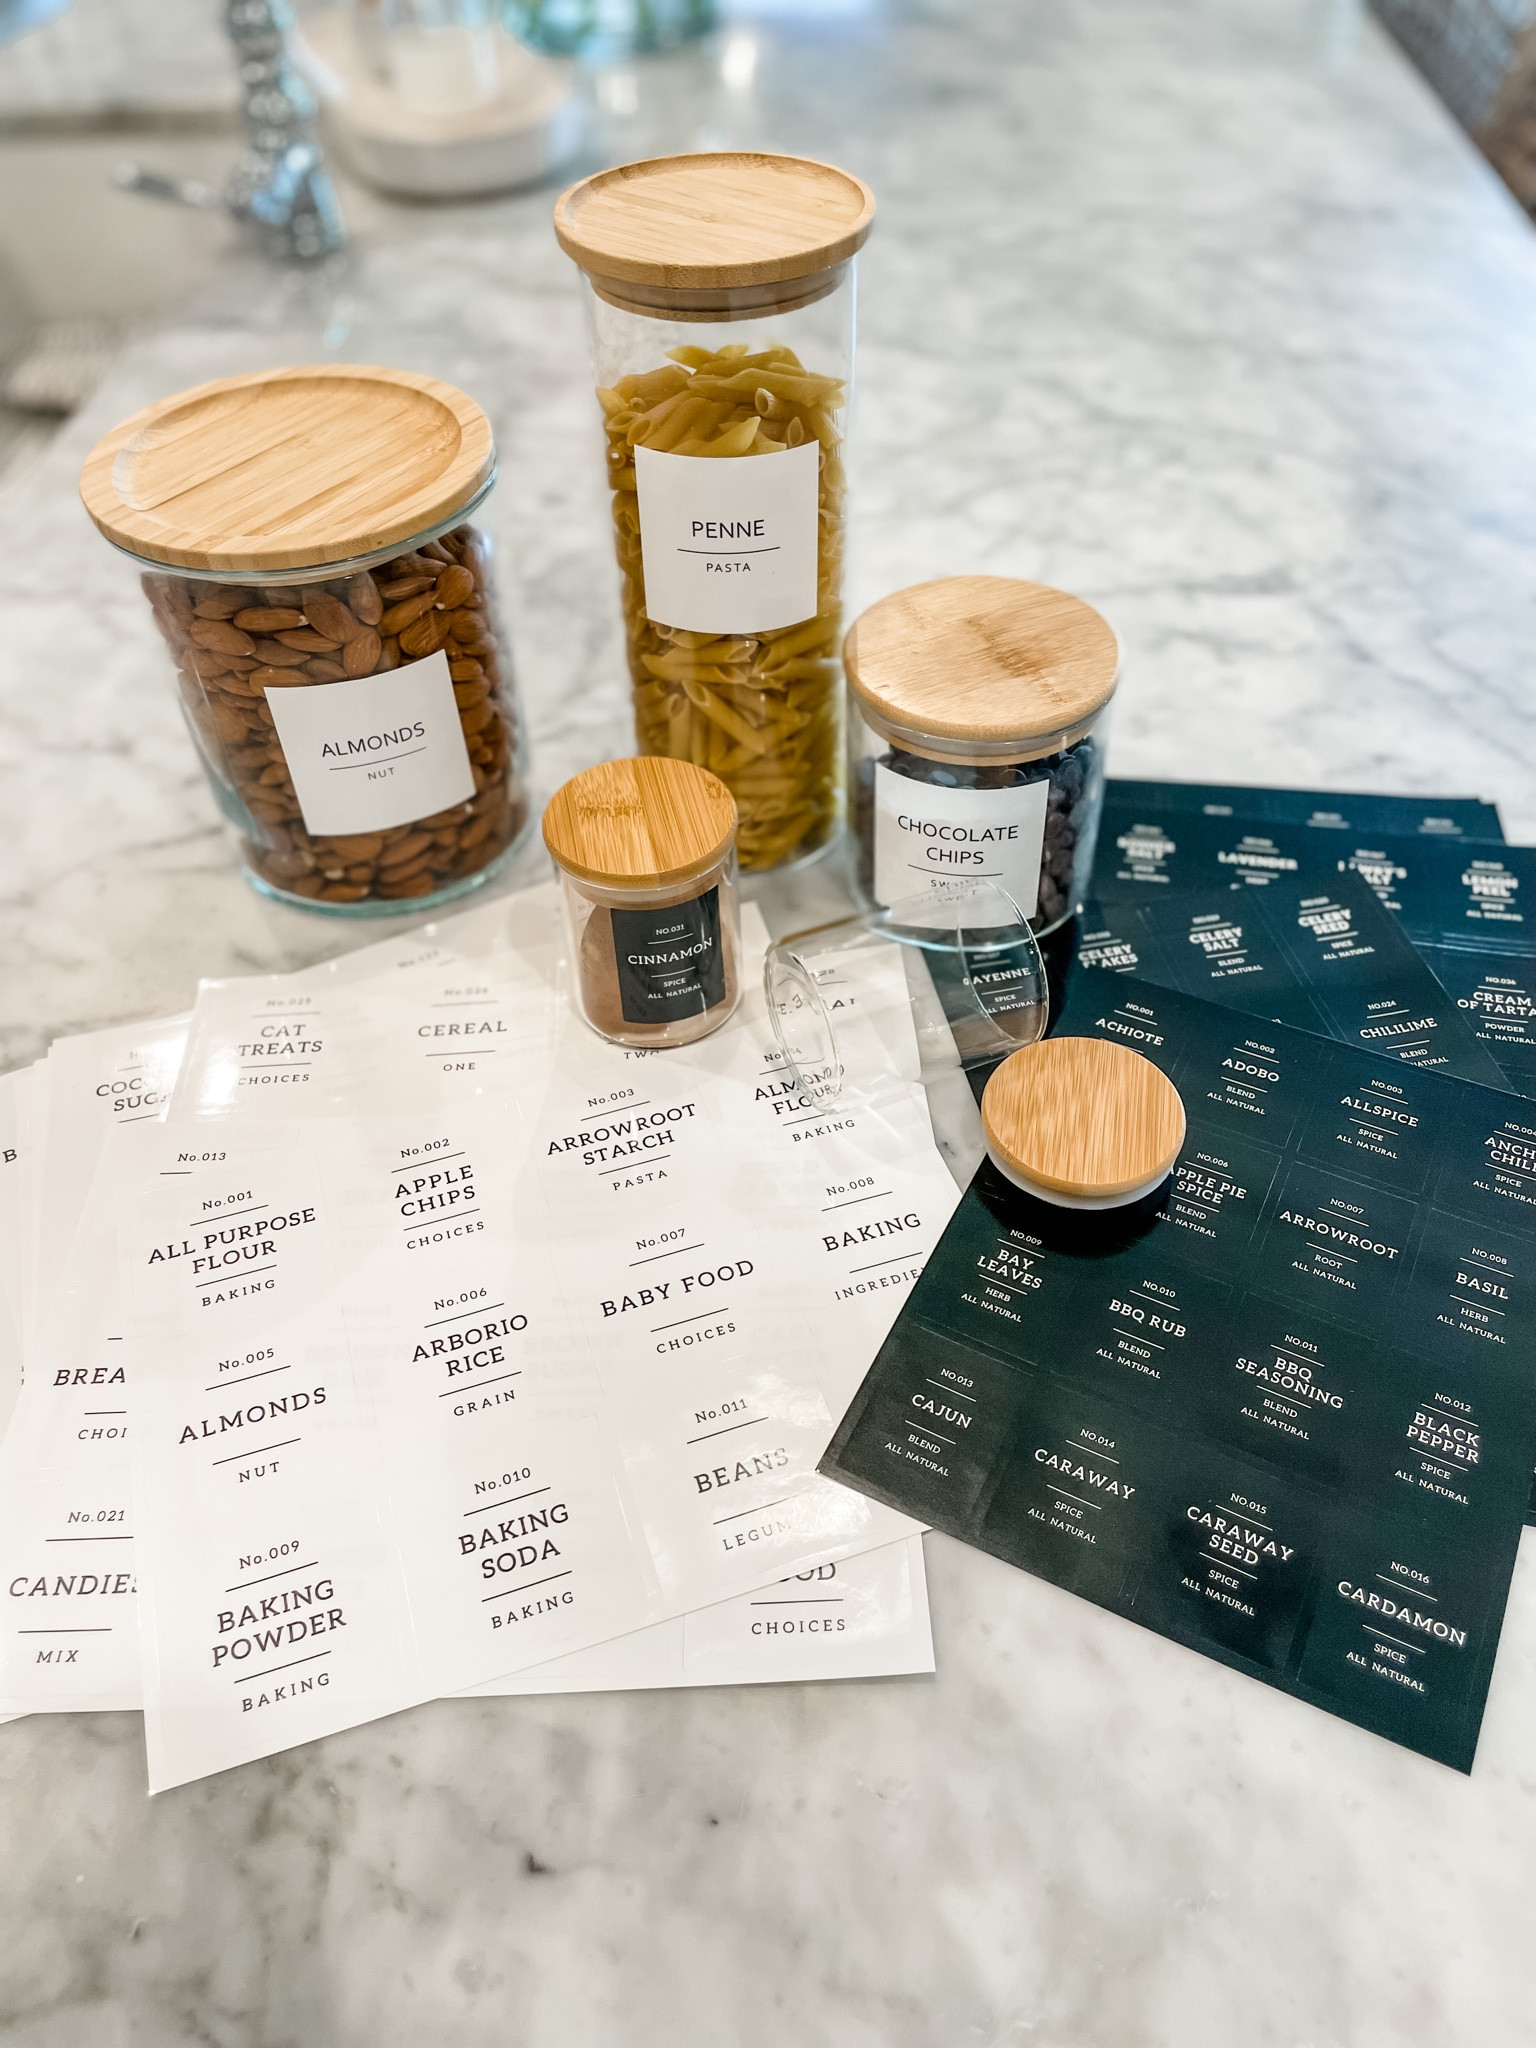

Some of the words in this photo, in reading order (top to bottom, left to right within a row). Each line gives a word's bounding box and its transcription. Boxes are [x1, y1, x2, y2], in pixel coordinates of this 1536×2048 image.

[692, 519, 765, 539] PENNE
[706, 563, 751, 572] PASTA
[321, 722, 425, 758] ALMONDS
[367, 767, 395, 780] NUT
[897, 815, 1018, 841] CHOCOLATE
[926, 847, 984, 865] CHIPS
[1298, 908, 1351, 928] CELERY
[1313, 920, 1350, 935] SEED
[655, 924, 685, 935] NO.031
[1189, 927, 1242, 944] CELERY
[627, 937, 713, 965] CINNAMON
[1078, 944, 1132, 962] CELERY
[1203, 938, 1239, 952] SALT
[1218, 958, 1245, 967] BLEND
[1227, 965, 1263, 975] NATURAL
[663, 978, 686, 987] SPICE
[666, 984, 702, 998] NATURAL
[1485, 976, 1516, 985] NO.036
[1125, 1002, 1154, 1016] NO.001
[1367, 1001, 1396, 1010] NO.024
[1457, 999, 1478, 1010] OF
[1473, 991, 1531, 1006] CREAM
[261, 1024, 306, 1037] CAT
[418, 1021, 508, 1037] CEREAL
[1095, 1018, 1164, 1046] ACHIOTE
[1360, 1018, 1437, 1038] CHILILIME
[1475, 1031, 1491, 1039] ALL
[1484, 1022, 1525, 1033] POWDER
[238, 1041, 323, 1057] TREATS
[1244, 1039, 1275, 1054] NO.002
[1400, 1048, 1428, 1059] BLEND
[443, 1062, 476, 1071] ONE
[1221, 1058, 1280, 1082] ADOBO
[238, 1074, 310, 1085] CHOICES
[1370, 1079, 1403, 1095] NO.003
[588, 1088, 635, 1107] No.003
[1207, 1091, 1223, 1102] ALL
[1226, 1097, 1266, 1115] NATURAL
[1226, 1085, 1256, 1100] BLEND
[1340, 1096, 1419, 1127] ALLSPICE
[547, 1103, 695, 1155] ARROWROOT
[792, 1119, 856, 1142] BAKING
[1358, 1128, 1384, 1142] SPICE
[400, 1138, 450, 1158] No.002
[583, 1130, 675, 1166] STARCH
[1336, 1133, 1352, 1144] ALL
[1356, 1140, 1398, 1159] NATURAL
[177, 1152, 227, 1162] No.013
[1196, 1152, 1229, 1168] NO.006
[395, 1165, 474, 1198] APPLE
[612, 1170, 667, 1190] PASTA
[826, 1177, 875, 1196] No.008
[1473, 1180, 1490, 1190] ALL
[1495, 1174, 1522, 1187] SPICE
[202, 1190, 253, 1210] No.001
[400, 1185, 475, 1216] CHIPS
[1176, 1181, 1223, 1204] SPICE
[1221, 1183, 1247, 1200] PIE
[1175, 1204, 1207, 1220] BLEND
[1330, 1198, 1365, 1214] NO.007
[407, 1221, 484, 1249] CHOICES
[822, 1213, 921, 1252] BAKING
[1155, 1211, 1172, 1222] ALL
[1174, 1218, 1217, 1238] NATURAL
[1279, 1210, 1399, 1260] ARROWROOT
[148, 1241, 196, 1265] ALL
[204, 1208, 316, 1250] PURPOSE
[636, 1228, 686, 1250] No.007
[1010, 1229, 1042, 1246] NO.009
[192, 1240, 277, 1274] FLOUR
[997, 1249, 1034, 1270] BAY
[1315, 1254, 1343, 1269] ROOT
[1471, 1248, 1507, 1265] NO.008
[976, 1255, 1043, 1289] LEAVES
[1291, 1261, 1309, 1272] ALL
[1312, 1268, 1357, 1289] NATURAL
[202, 1280, 275, 1307] BAKING
[600, 1282, 670, 1317] BABY
[681, 1260, 753, 1293] FOOD
[985, 1287, 1011, 1302] HERB
[1142, 1280, 1176, 1298] NO.010
[1455, 1272, 1509, 1300] BASIL
[434, 1288, 487, 1310] No.006
[961, 1293, 978, 1304] ALL
[980, 1300, 1022, 1322] NATURAL
[1109, 1299, 1145, 1323] BBQ
[1149, 1315, 1187, 1337] RUB
[1460, 1307, 1489, 1323] HERB
[412, 1314, 528, 1362] ARBORIO
[656, 1322, 736, 1353] CHOICES
[1436, 1314, 1455, 1325] ALL
[1459, 1322, 1506, 1344] NATURAL
[1117, 1340, 1151, 1359] BLEND
[1284, 1334, 1318, 1353] NO.011
[218, 1348, 275, 1372] No.005
[445, 1346, 505, 1377] RICE
[1096, 1348, 1113, 1359] ALL
[1117, 1356, 1161, 1379] NATURAL
[1274, 1357, 1312, 1383] BBQ
[940, 1368, 974, 1388] NO.013
[1236, 1358, 1343, 1409] SEASONING
[454, 1390, 515, 1416] GRAIN
[695, 1398, 748, 1423] No.011
[912, 1394, 972, 1429] CAJUN
[1263, 1399, 1298, 1418] BLEND
[1434, 1393, 1471, 1412] NO.012
[178, 1387, 327, 1445] ALMONDS
[1241, 1407, 1259, 1419] ALL
[1263, 1415, 1309, 1440] NATURAL
[1080, 1428, 1115, 1449] NO.014
[1414, 1411, 1480, 1447] BLACK
[907, 1434, 941, 1454] BLEND
[1406, 1425, 1479, 1463] PEPPER
[884, 1442, 902, 1454] ALL
[905, 1451, 950, 1476] NATURAL
[238, 1461, 280, 1483] NUT
[474, 1467, 531, 1494] No.010
[694, 1448, 789, 1493] BEANS
[1034, 1448, 1136, 1499] CARAWAY
[1421, 1463, 1451, 1480] SPICE
[1395, 1469, 1414, 1483] ALL
[1418, 1478, 1469, 1505] NATURAL
[1054, 1500, 1084, 1520] SPICE
[1230, 1493, 1267, 1514] NO.015
[67, 1510, 125, 1523] No.021
[1027, 1507, 1046, 1520] ALL
[1050, 1518, 1096, 1543] NATURAL
[458, 1503, 569, 1555] BAKING
[1186, 1506, 1294, 1561] CARAWAY
[239, 1540, 300, 1569] No.009
[481, 1539, 561, 1579] SODA
[1209, 1534, 1260, 1565] SEED
[1208, 1569, 1239, 1589] SPICE
[1390, 1561, 1430, 1584] NO.016
[217, 1579, 334, 1633] BAKING
[1181, 1577, 1200, 1591] ALL
[1205, 1587, 1254, 1616] NATURAL
[491, 1591, 574, 1629] BAKING
[1338, 1580, 1466, 1645] CARDAMON
[751, 1619, 845, 1634] CHOICES
[211, 1608, 347, 1667] POWDER
[35, 1650, 79, 1663] MIX
[1374, 1643, 1407, 1664] SPICE
[1346, 1651, 1366, 1667] ALL
[1371, 1661, 1425, 1692] NATURAL
[242, 1673, 330, 1712] BAKING
